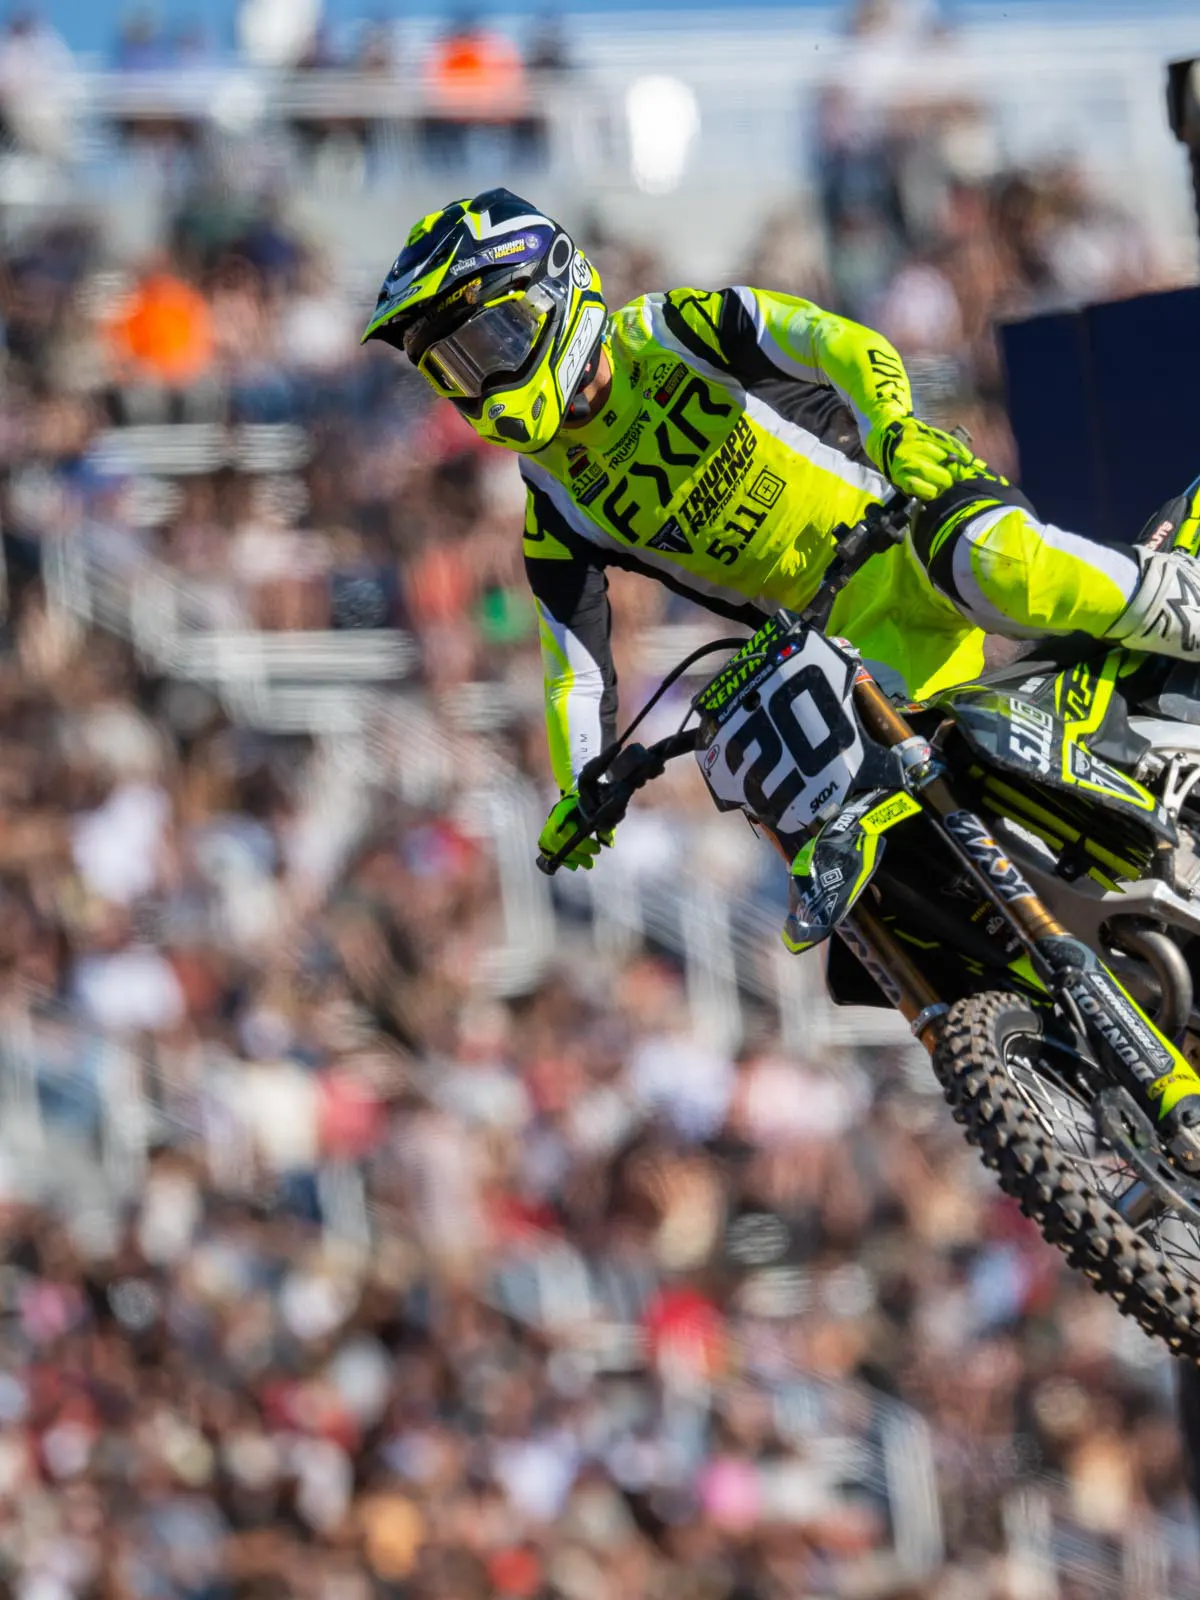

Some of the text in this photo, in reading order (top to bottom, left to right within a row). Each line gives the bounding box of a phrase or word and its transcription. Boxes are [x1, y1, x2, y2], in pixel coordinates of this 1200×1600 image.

[493, 238, 525, 252] TRIUMPH
[495, 245, 526, 259] RACING
[602, 375, 733, 544] FXR
[608, 421, 646, 471] TRIUMPH
[678, 415, 752, 523] TRIUMPH
[690, 433, 758, 536] RACING
[708, 484, 738, 527] FACTORY
[705, 504, 768, 566] 5.11
[725, 664, 856, 828] 20
